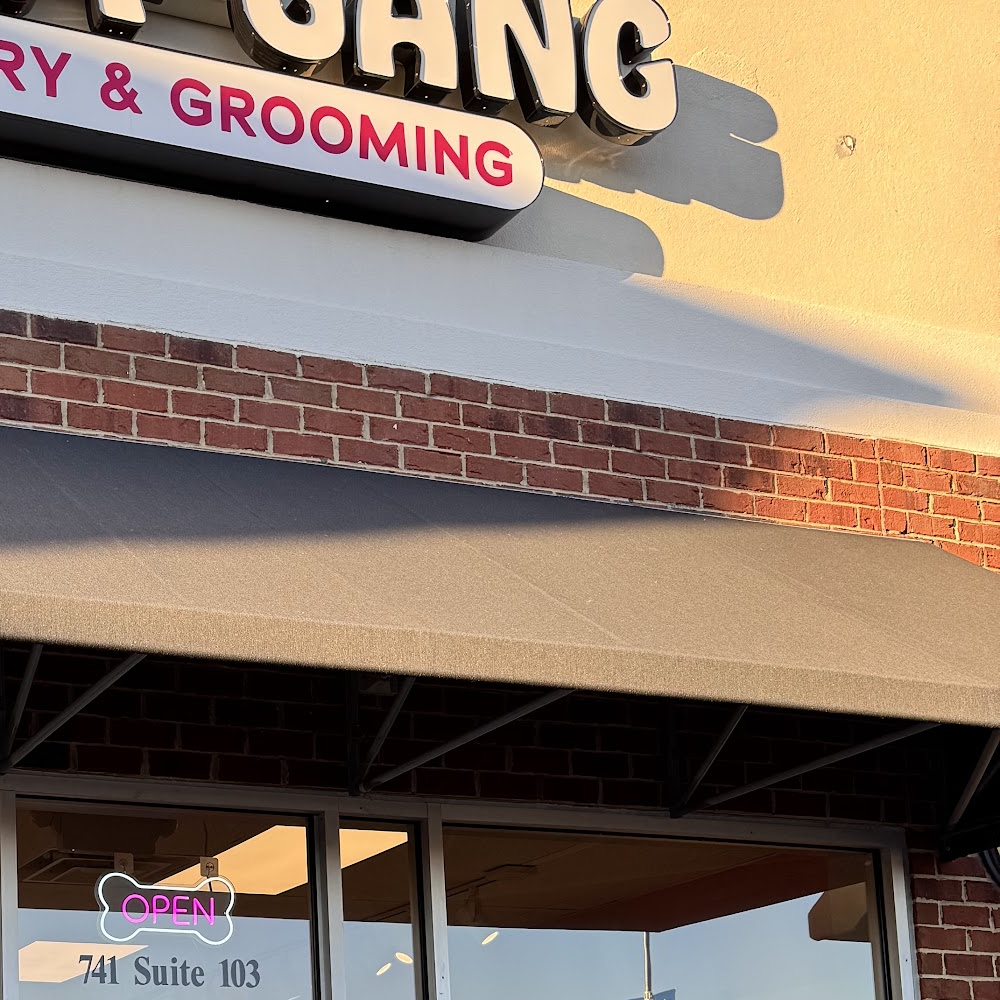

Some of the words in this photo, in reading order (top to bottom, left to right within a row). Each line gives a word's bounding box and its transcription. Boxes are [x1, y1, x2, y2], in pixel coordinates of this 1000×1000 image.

[100, 62, 143, 115] &
[170, 76, 513, 188] GROOMING
[121, 893, 216, 926] OPEN
[78, 954, 119, 985] 741
[134, 955, 205, 988] Suite
[219, 958, 261, 989] 103
